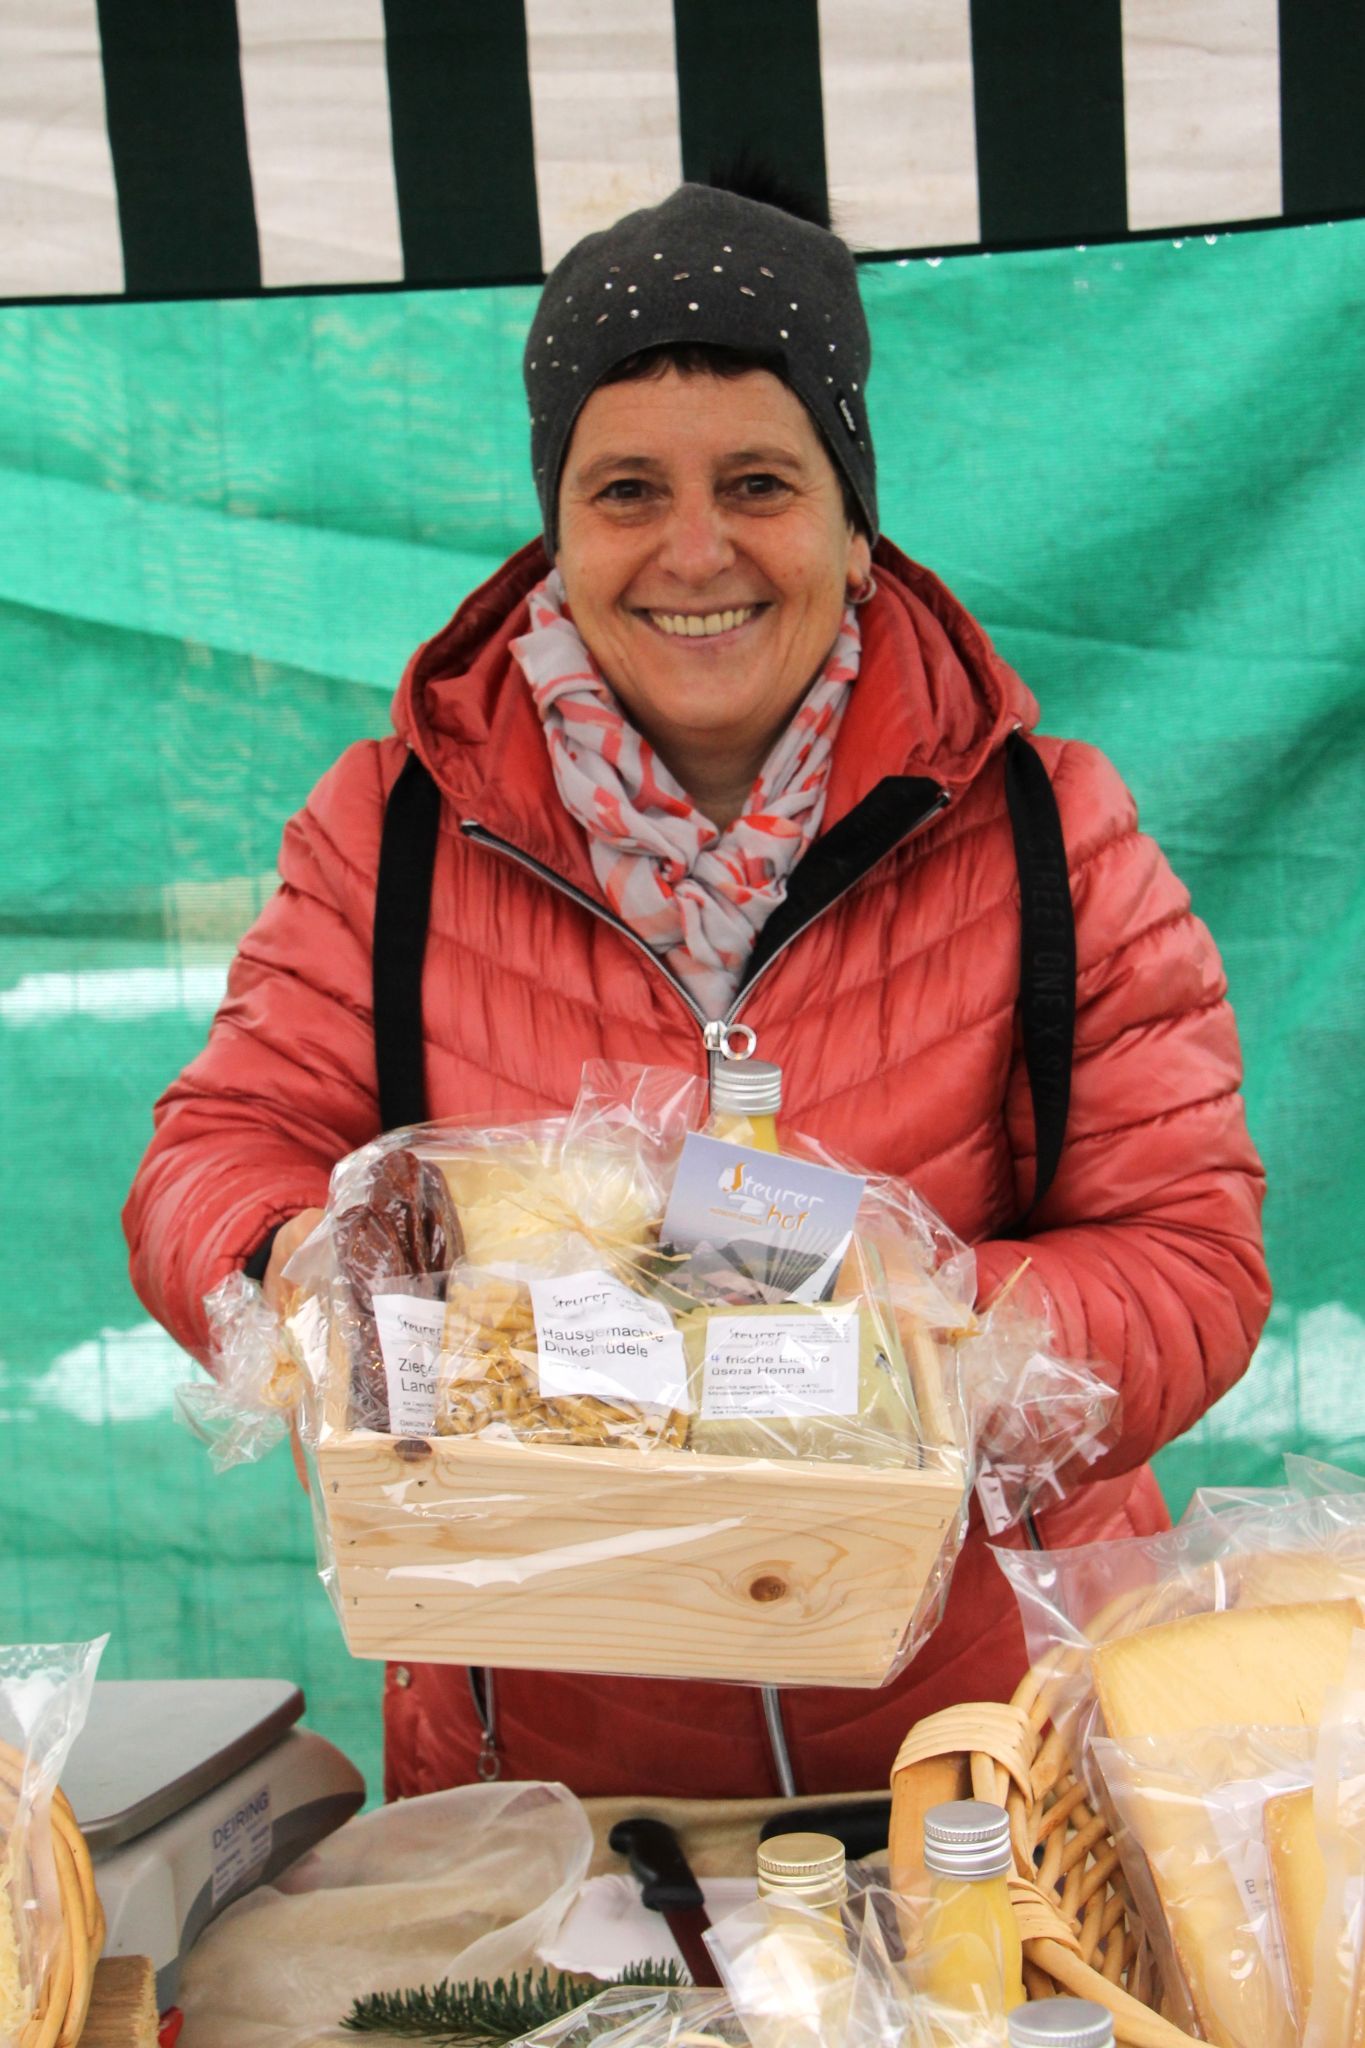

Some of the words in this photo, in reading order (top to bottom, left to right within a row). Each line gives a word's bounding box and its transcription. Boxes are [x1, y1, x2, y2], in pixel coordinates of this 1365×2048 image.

[722, 1162, 825, 1208] Steurer
[767, 1204, 810, 1232] hof
[725, 1354, 774, 1364] frische
[757, 1366, 805, 1375] Henna
[212, 1791, 269, 1849] DEIRING
